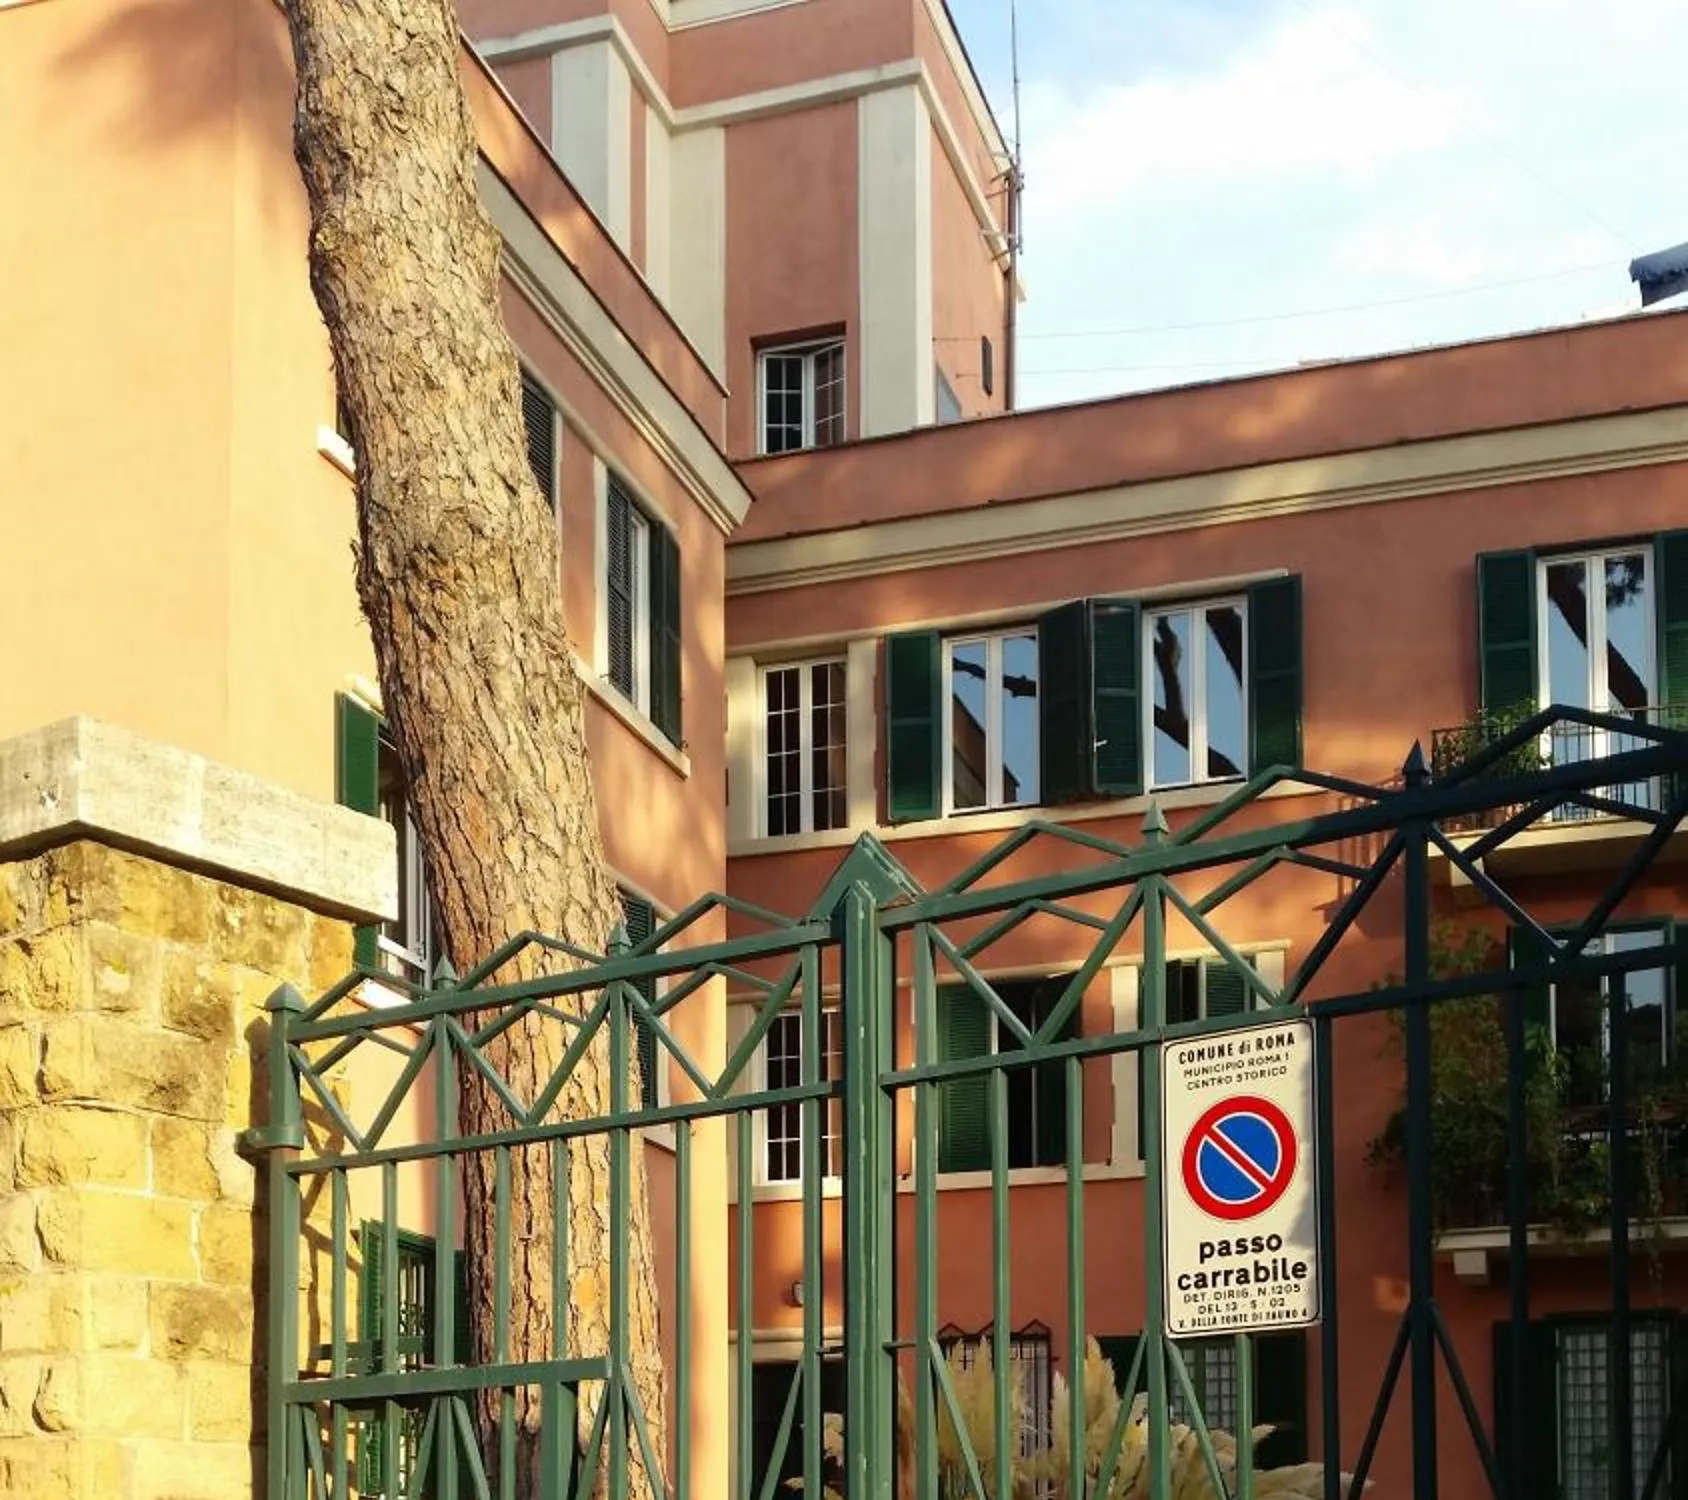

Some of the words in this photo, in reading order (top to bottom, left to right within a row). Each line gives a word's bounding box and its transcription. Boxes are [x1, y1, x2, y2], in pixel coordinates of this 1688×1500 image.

[1180, 1043, 1233, 1064] COMUNE
[1239, 1041, 1251, 1054] di
[1256, 1032, 1295, 1051] ROMA
[1183, 1060, 1244, 1078] MUNICIPIO
[1248, 1054, 1283, 1067] ROMA
[1187, 1076, 1232, 1091] CENTRO
[1236, 1066, 1287, 1083] STORICO
[1199, 1234, 1282, 1264] passo
[1177, 1258, 1307, 1291] carrabile
[1198, 1304, 1224, 1314] DEL
